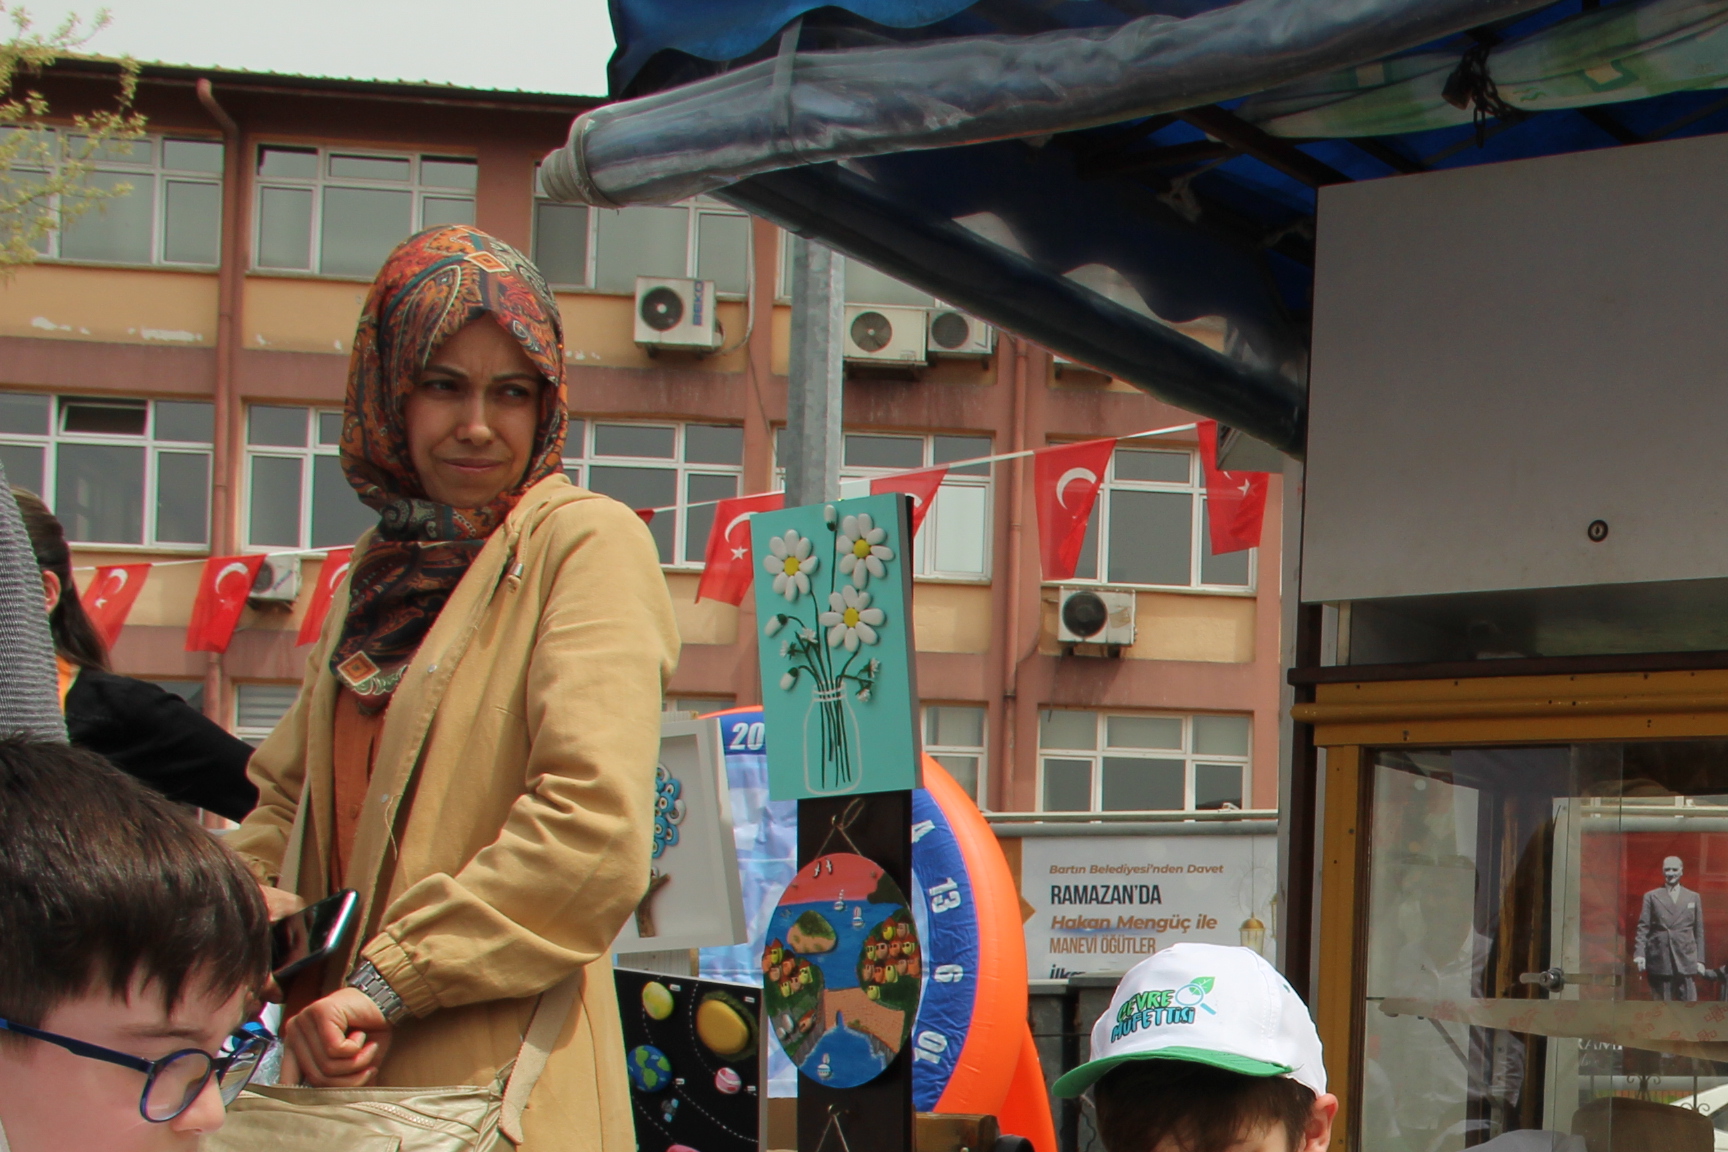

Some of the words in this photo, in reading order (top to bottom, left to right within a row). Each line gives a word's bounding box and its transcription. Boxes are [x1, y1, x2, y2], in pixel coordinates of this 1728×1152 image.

[730, 722, 766, 750] 20
[1049, 864, 1087, 875] Bartın
[1089, 863, 1184, 876] Belediyesi'nden
[1187, 864, 1225, 874] Davet
[928, 876, 962, 915] 13
[1050, 884, 1163, 905] RAMAZAN'DA
[1051, 915, 1112, 930] Hakan
[1116, 914, 1192, 934] Mengüç
[1195, 913, 1218, 930] ile
[1049, 934, 1098, 954] MANEVİ
[1101, 933, 1157, 954] ÖĞÜTLER
[933, 964, 964, 984] 6
[914, 1030, 948, 1065] 10
